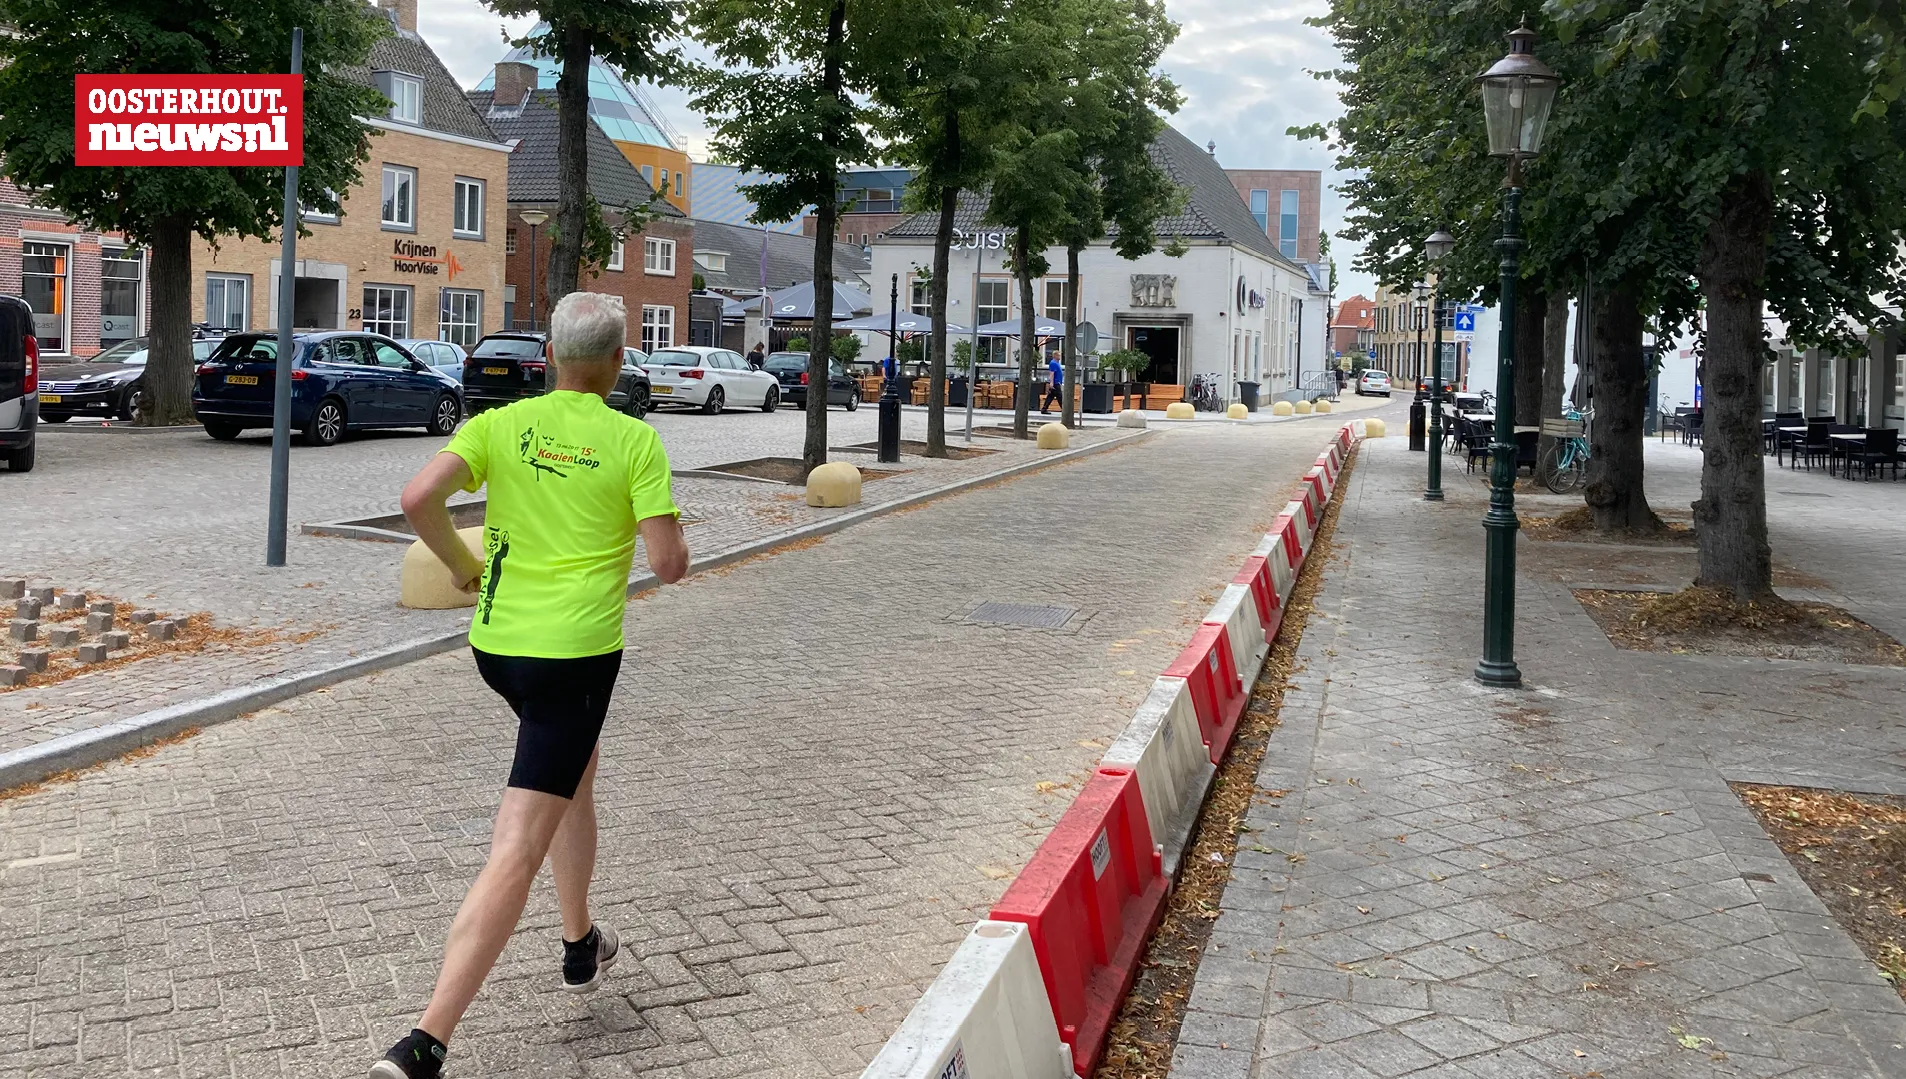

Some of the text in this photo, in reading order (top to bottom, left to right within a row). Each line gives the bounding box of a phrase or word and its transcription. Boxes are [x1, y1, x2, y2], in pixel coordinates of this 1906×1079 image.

[394, 239, 437, 258] Krijnen
[394, 260, 438, 275] HoorVisie
[349, 309, 361, 319] 23
[35, 321, 55, 329] cast
[103, 320, 130, 331] Qcast
[537, 448, 600, 469] KaaienLoop
